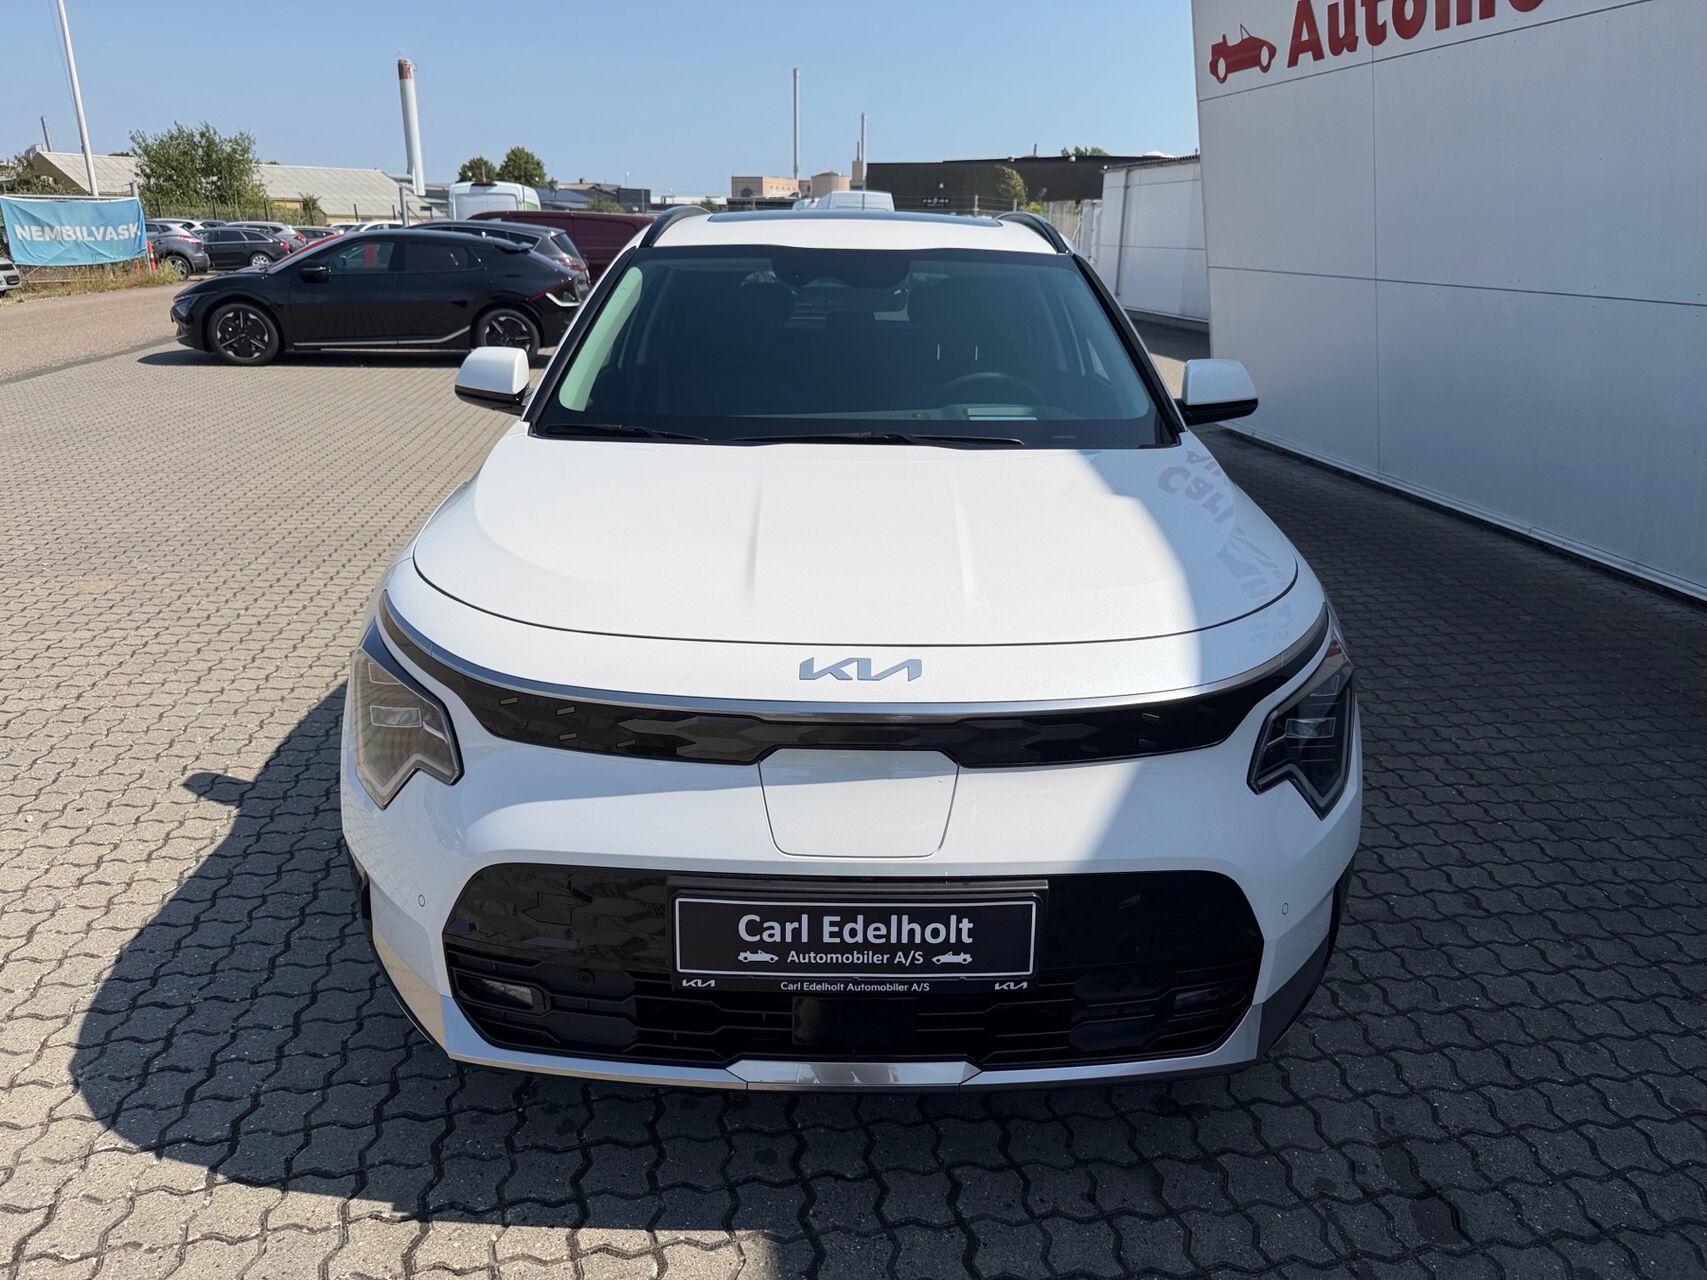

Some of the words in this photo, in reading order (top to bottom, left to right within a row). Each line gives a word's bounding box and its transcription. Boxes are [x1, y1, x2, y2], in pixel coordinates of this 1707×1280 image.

[1287, 0, 1545, 68] Auto
[799, 656, 922, 681] KIA
[738, 914, 809, 943] Carl
[822, 914, 974, 944] Edelholt
[786, 950, 890, 964] Automobiler
[894, 950, 925, 966] A/S
[682, 978, 716, 988] KIA
[780, 981, 801, 991] Carl
[803, 981, 845, 991] Edelholt
[846, 982, 909, 992] Automobiler
[911, 982, 931, 993] A/S
[994, 981, 1028, 991] KIA
